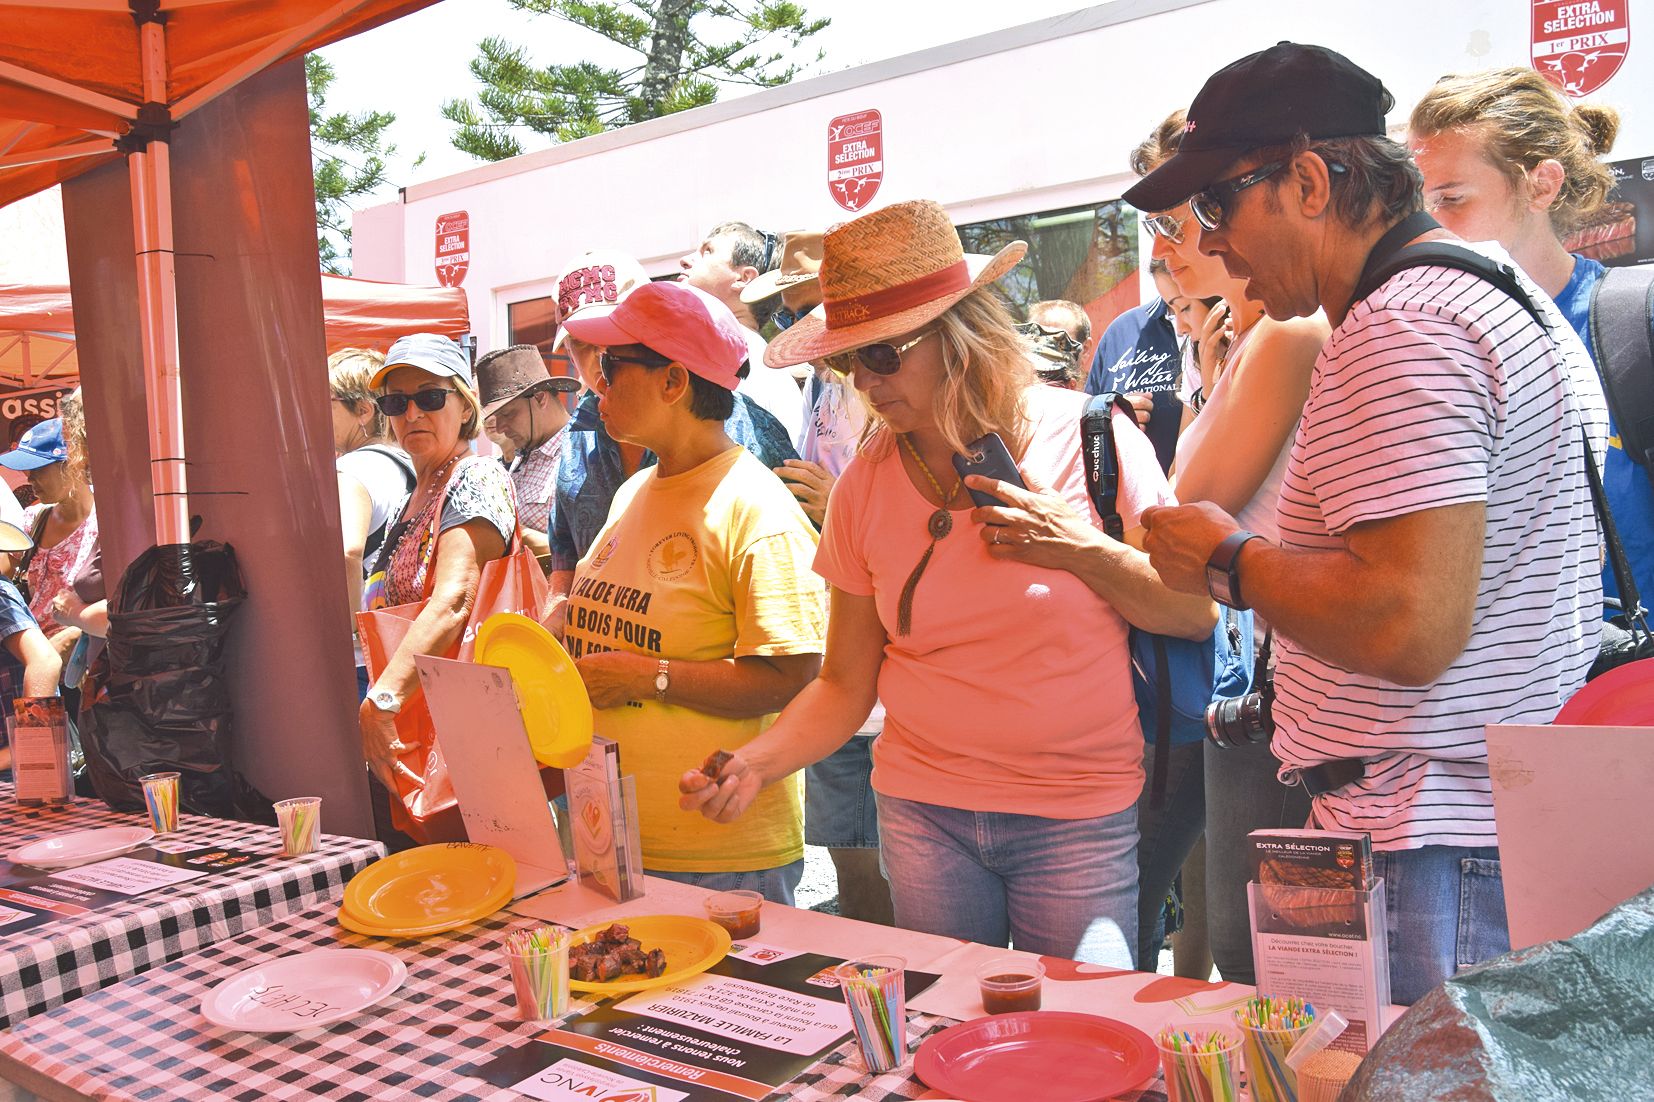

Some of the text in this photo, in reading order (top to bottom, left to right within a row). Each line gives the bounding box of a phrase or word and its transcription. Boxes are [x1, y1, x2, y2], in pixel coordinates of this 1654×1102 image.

[1557, 1, 1601, 19] EXTRA
[1543, 10, 1615, 34] SELECTION
[1550, 33, 1609, 54] 1er PRIX
[842, 140, 868, 154] EXTRA
[834, 147, 876, 165] SELECTION
[852, 163, 875, 176] PRIX
[439, 241, 465, 253] SELECTION
[444, 235, 460, 245] EXTRA
[1124, 367, 1174, 391] Water
[1091, 434, 1101, 483] Quechua
[612, 585, 653, 616] VERA
[566, 603, 575, 627] N
[576, 606, 612, 637] BOIS
[614, 617, 663, 653] POUR
[1256, 842, 1283, 850] EXTRA
[1285, 842, 1331, 852] SÉLECTION
[1301, 940, 1315, 948] chez
[1322, 949, 1354, 957] SÉLECTION
[698, 1001, 729, 1012] depuis
[734, 1001, 774, 1014] carcasse
[750, 996, 776, 1007] Extra
[778, 995, 802, 1006] Race
[727, 1008, 762, 1022] Bourail
[776, 1004, 801, 1013] mâle
[647, 1003, 793, 1045] La FAMILLE MAZURIER
[783, 1014, 813, 1025] fourni
[608, 1027, 747, 1068] Nous tenons à remercier
[641, 1025, 741, 1056] chaleureusement
[593, 1042, 707, 1081] Remerciements
[539, 1072, 608, 1098] IVNC
